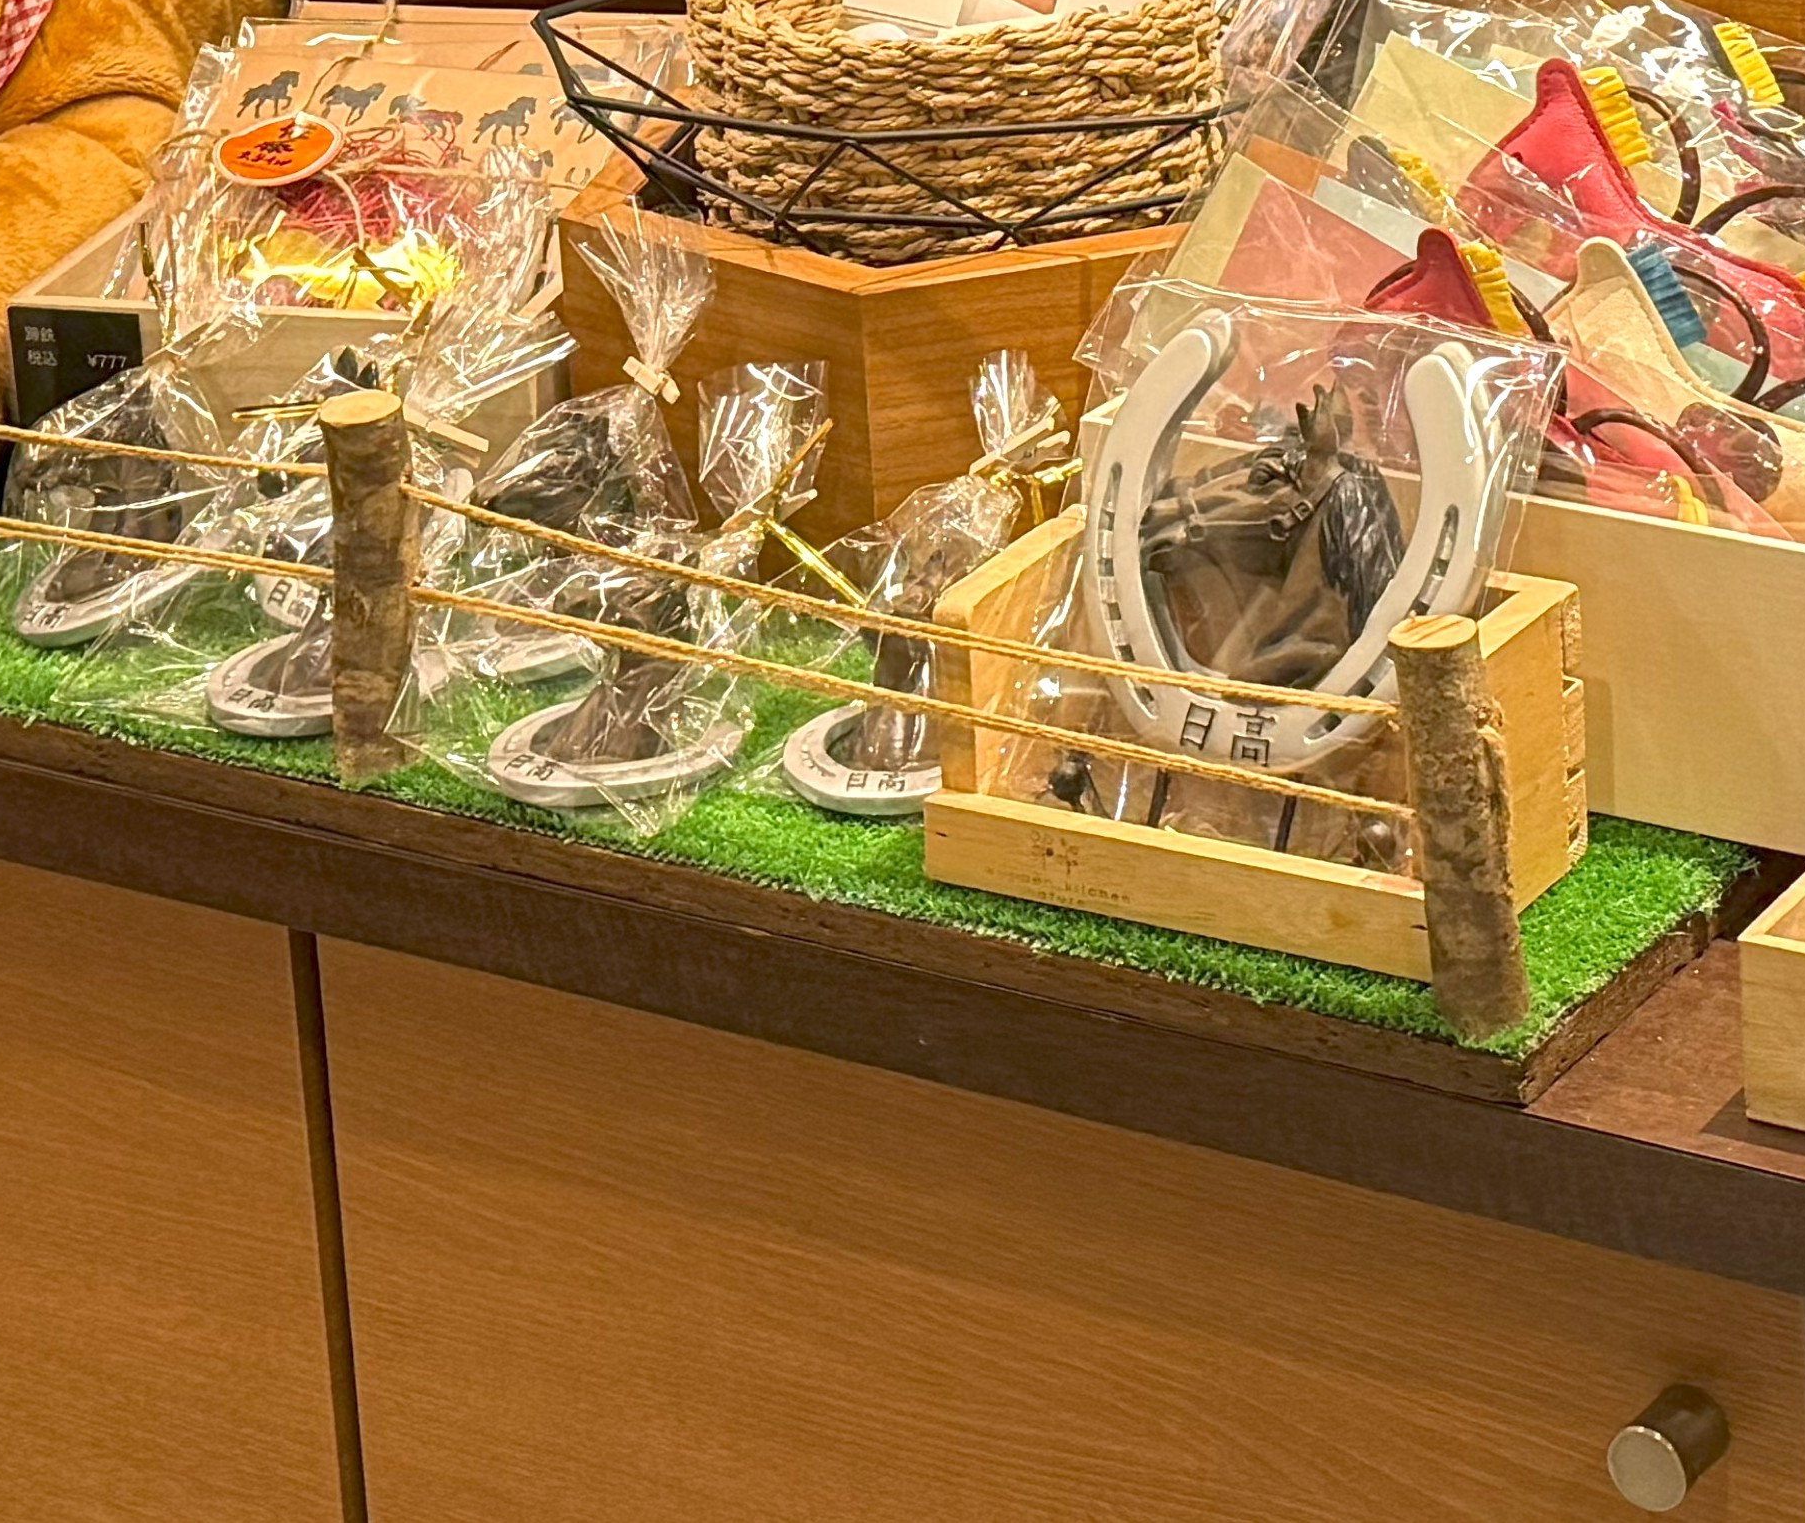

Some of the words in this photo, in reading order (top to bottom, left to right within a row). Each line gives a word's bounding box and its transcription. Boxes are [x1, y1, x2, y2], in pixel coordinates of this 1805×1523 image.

[27, 350, 59, 368] 税込
[86, 354, 127, 370] ¥777
[1180, 701, 1278, 768] 日高
[845, 770, 907, 793] 日高
